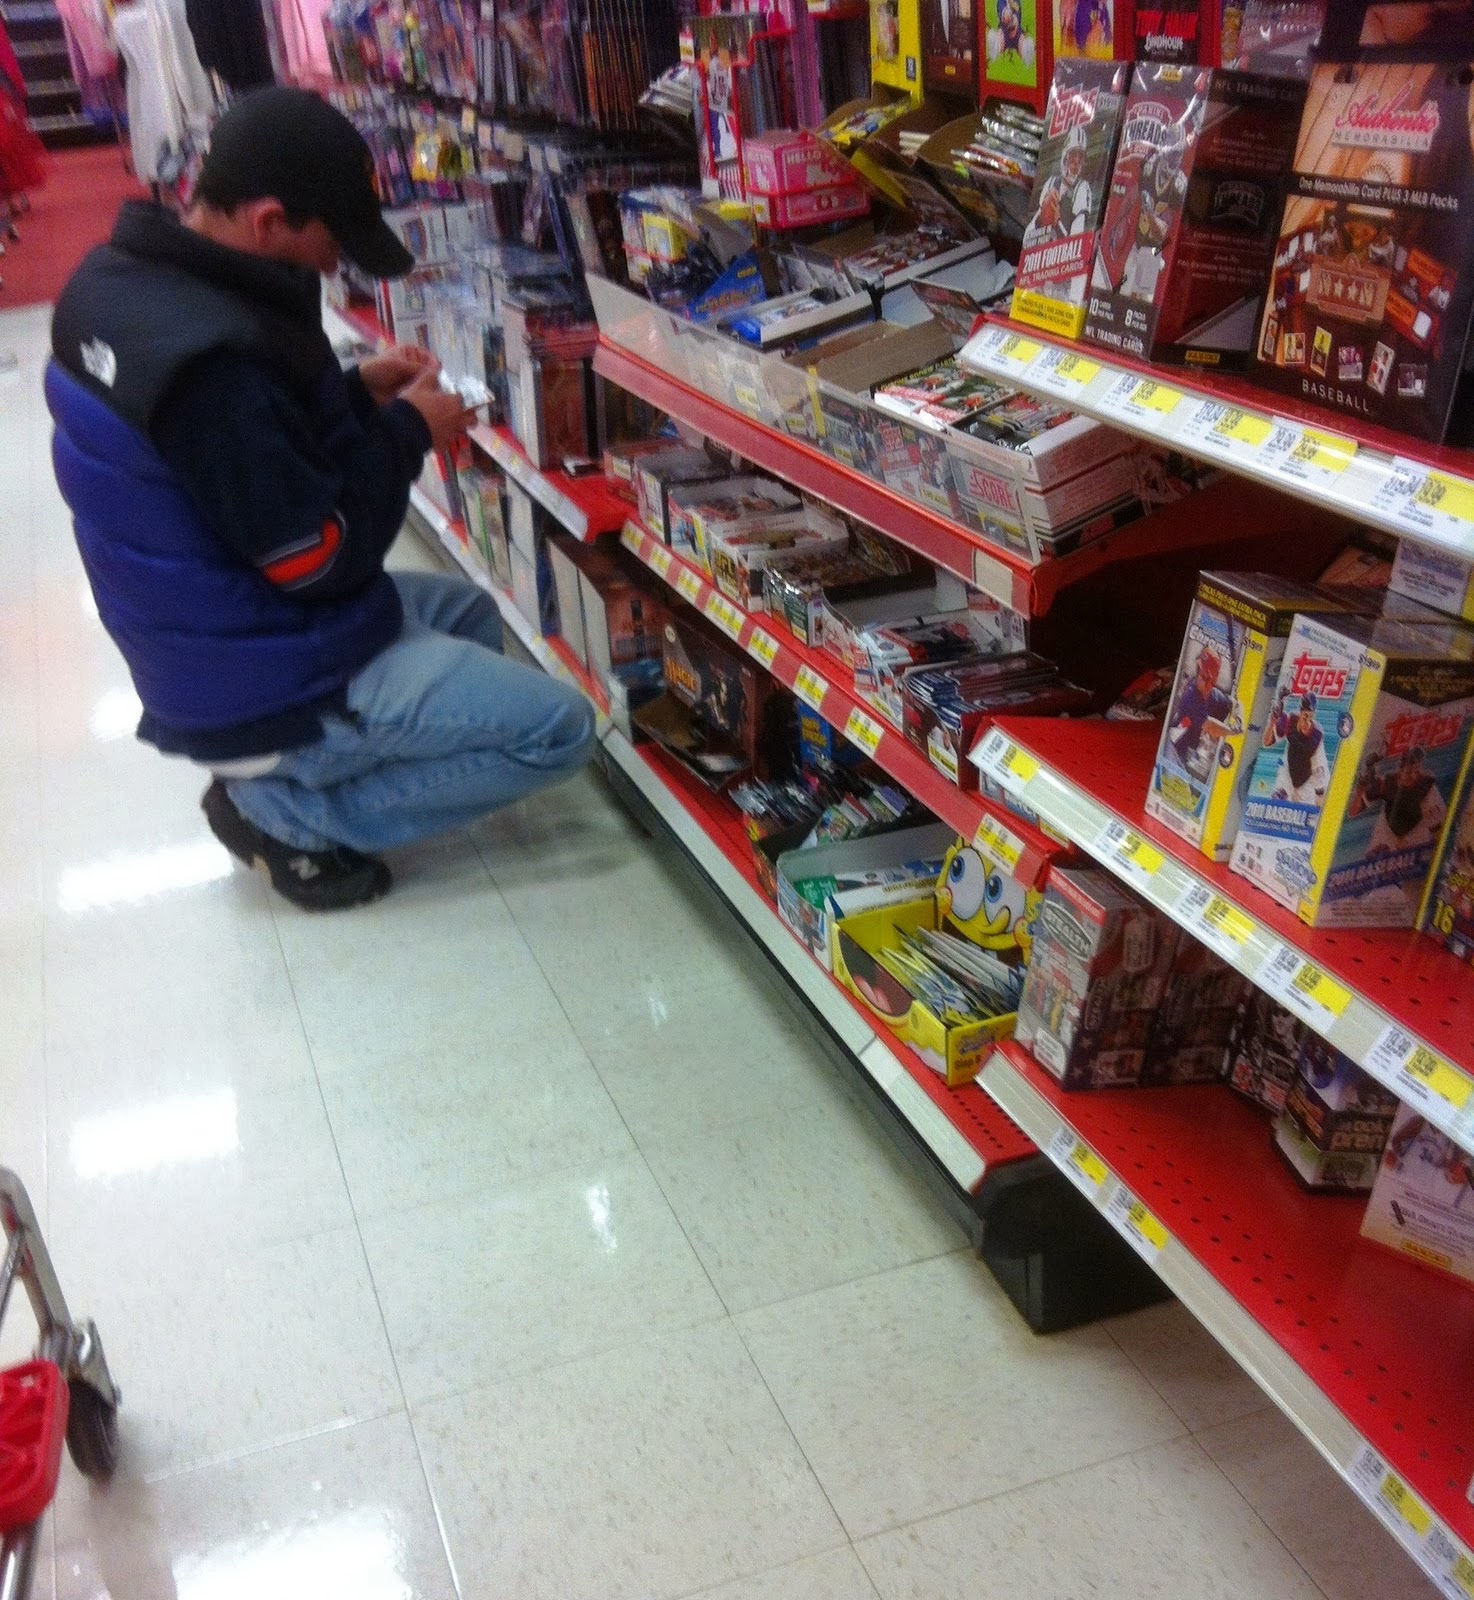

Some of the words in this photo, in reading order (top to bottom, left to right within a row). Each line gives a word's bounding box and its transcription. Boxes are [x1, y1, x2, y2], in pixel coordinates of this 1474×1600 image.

[1334, 131, 1429, 148] MEMORABILIA
[1299, 176, 1313, 189] One
[1313, 179, 1359, 196] Memorabilia
[1361, 184, 1382, 198] Card
[1382, 187, 1402, 200] PLUS
[1403, 190, 1410, 202] 3
[1429, 192, 1459, 210] Packs
[1022, 250, 1043, 274] 2011
[1041, 238, 1083, 269] FOOTBALL
[1060, 259, 1085, 275] CARDS
[1089, 297, 1099, 316] 10
[1124, 308, 1133, 327] 8
[1096, 328, 1122, 348] TRADING
[1122, 335, 1145, 353] CARDS
[1302, 378, 1370, 412] BASEBALL
[1291, 650, 1349, 699] TOPPS
[1245, 802, 1265, 820] 2011
[1264, 804, 1308, 826] BASEBALL
[1044, 907, 1090, 954] STEALTH
[1434, 900, 1456, 935] 16
